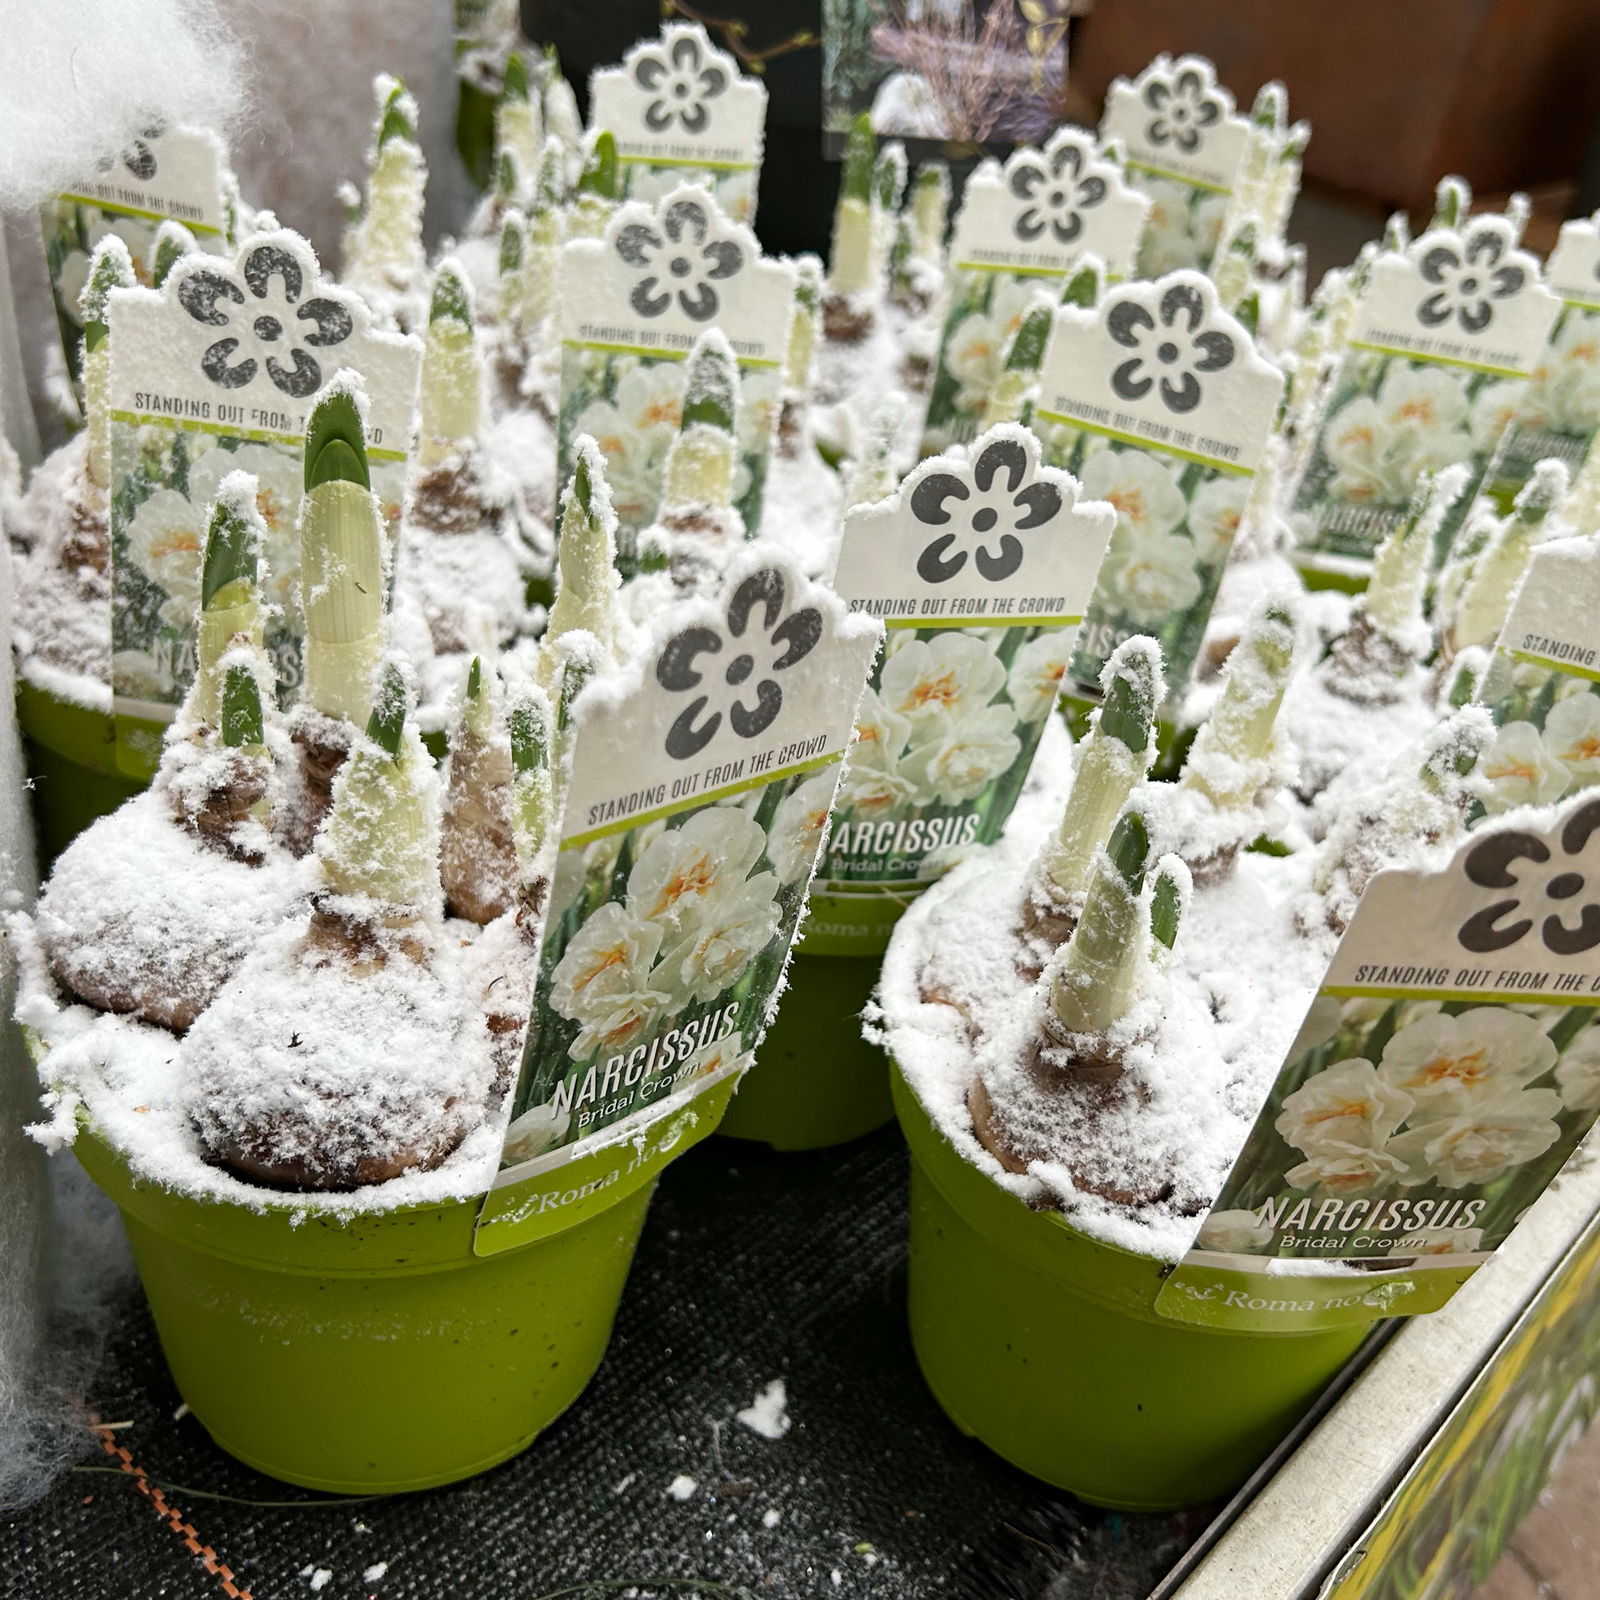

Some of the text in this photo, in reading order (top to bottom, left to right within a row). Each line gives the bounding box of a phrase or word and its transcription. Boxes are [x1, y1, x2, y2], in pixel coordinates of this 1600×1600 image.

[135, 392, 210, 419] STANDING
[218, 404, 245, 424] OUT
[850, 597, 1065, 615] STANDING OUT FROM THE CROWD
[1522, 634, 1596, 666] STANDING
[588, 734, 827, 826] STANDING OUT FROM THE CROWD
[829, 813, 980, 855] ARCISSUS
[831, 857, 883, 873] Bridal
[1355, 965, 1450, 985] STANDING
[1454, 968, 1492, 987] OUT
[1494, 971, 1550, 990] FROM
[1553, 973, 1588, 992] THE
[550, 1002, 739, 1120] NARCISSUS
[577, 1063, 701, 1128] Bridal Crown
[536, 1169, 620, 1214] Roma
[1253, 1196, 1487, 1232] NARCISSUS
[1279, 1235, 1427, 1249] Bridal Crown
[1224, 1290, 1315, 1312] Roma
